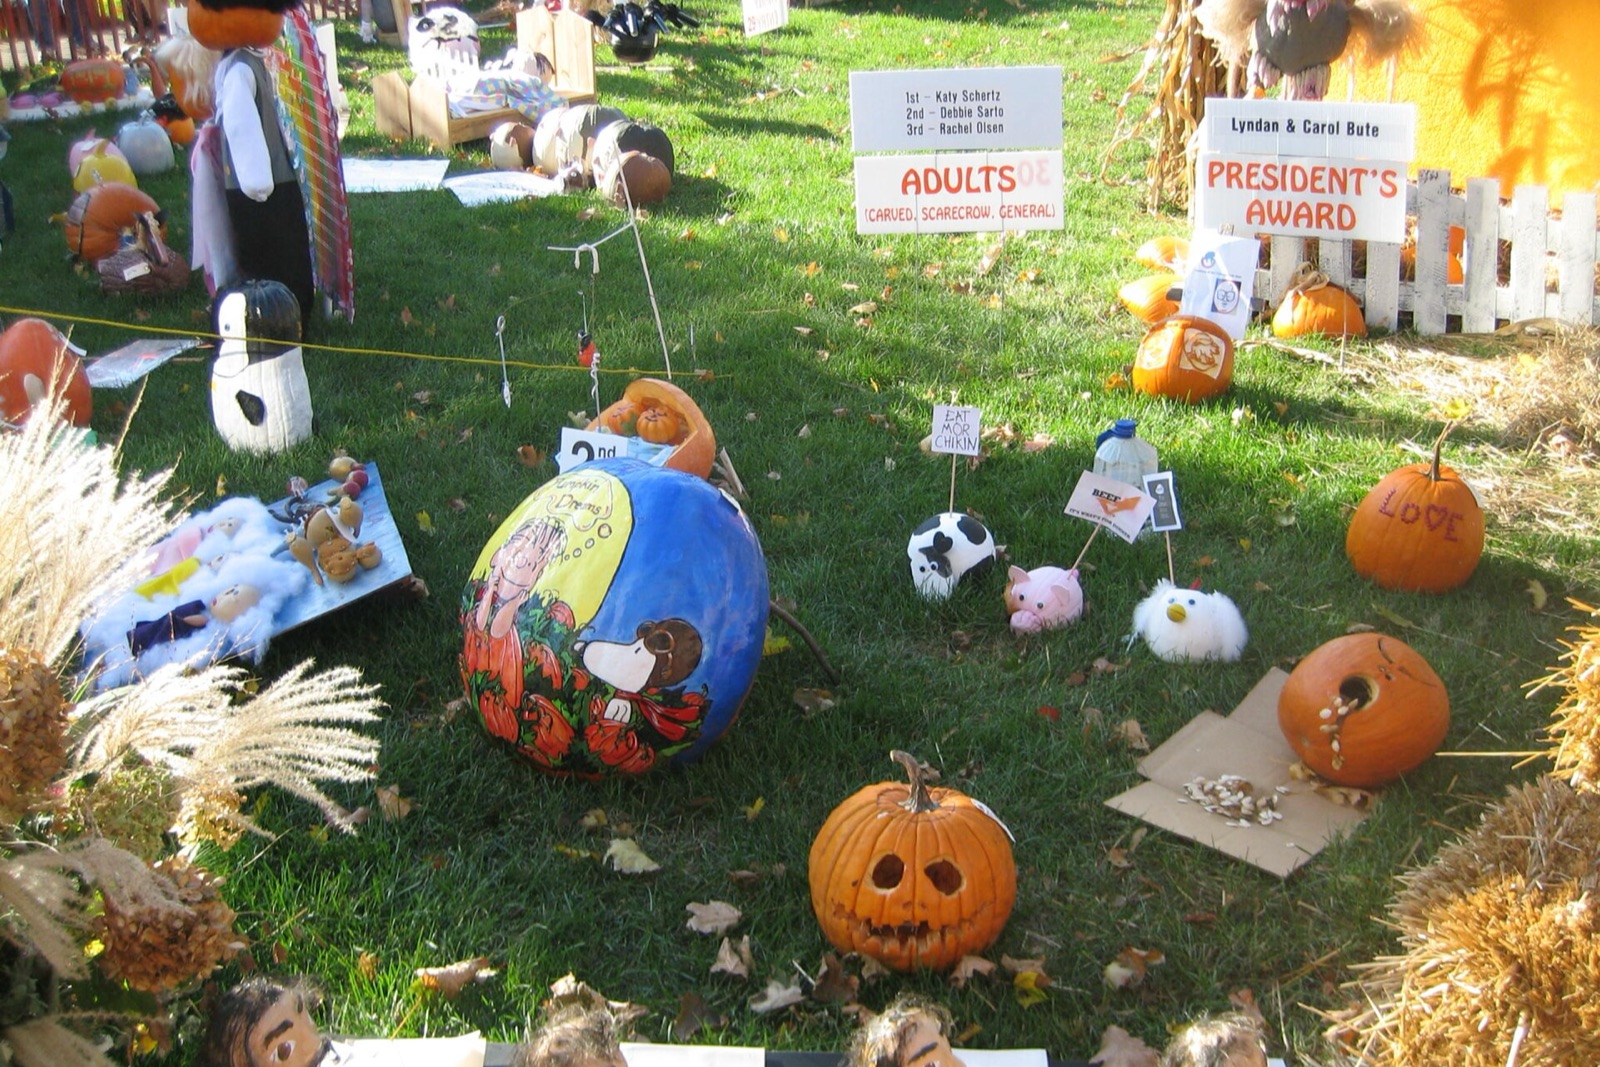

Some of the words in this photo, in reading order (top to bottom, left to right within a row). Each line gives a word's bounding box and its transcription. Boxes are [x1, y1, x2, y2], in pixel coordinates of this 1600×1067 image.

[906, 91, 919, 104] 1st
[936, 90, 957, 104] Katy
[962, 89, 1001, 102] Schertz
[906, 107, 924, 120] 2nd
[940, 106, 973, 119] Debbie
[977, 105, 1004, 118] Sarto
[907, 123, 924, 136] 3rd
[940, 121, 973, 135] Rachel
[976, 121, 1004, 134] Olsen
[1231, 117, 1279, 134] Lyndan
[1286, 119, 1296, 133] &
[1303, 119, 1340, 135] Carol
[1346, 121, 1379, 137] Bute
[901, 165, 1016, 195] ADULTS
[1208, 160, 1398, 199] PRESIDENT'S
[999, 203, 1056, 219] GENERAL)
[1246, 199, 1357, 231] AWARD
[945, 409, 970, 422] EAT
[942, 422, 970, 436] MOR
[935, 435, 977, 451] CHIKIN
[1092, 488, 1121, 503] BEEF
